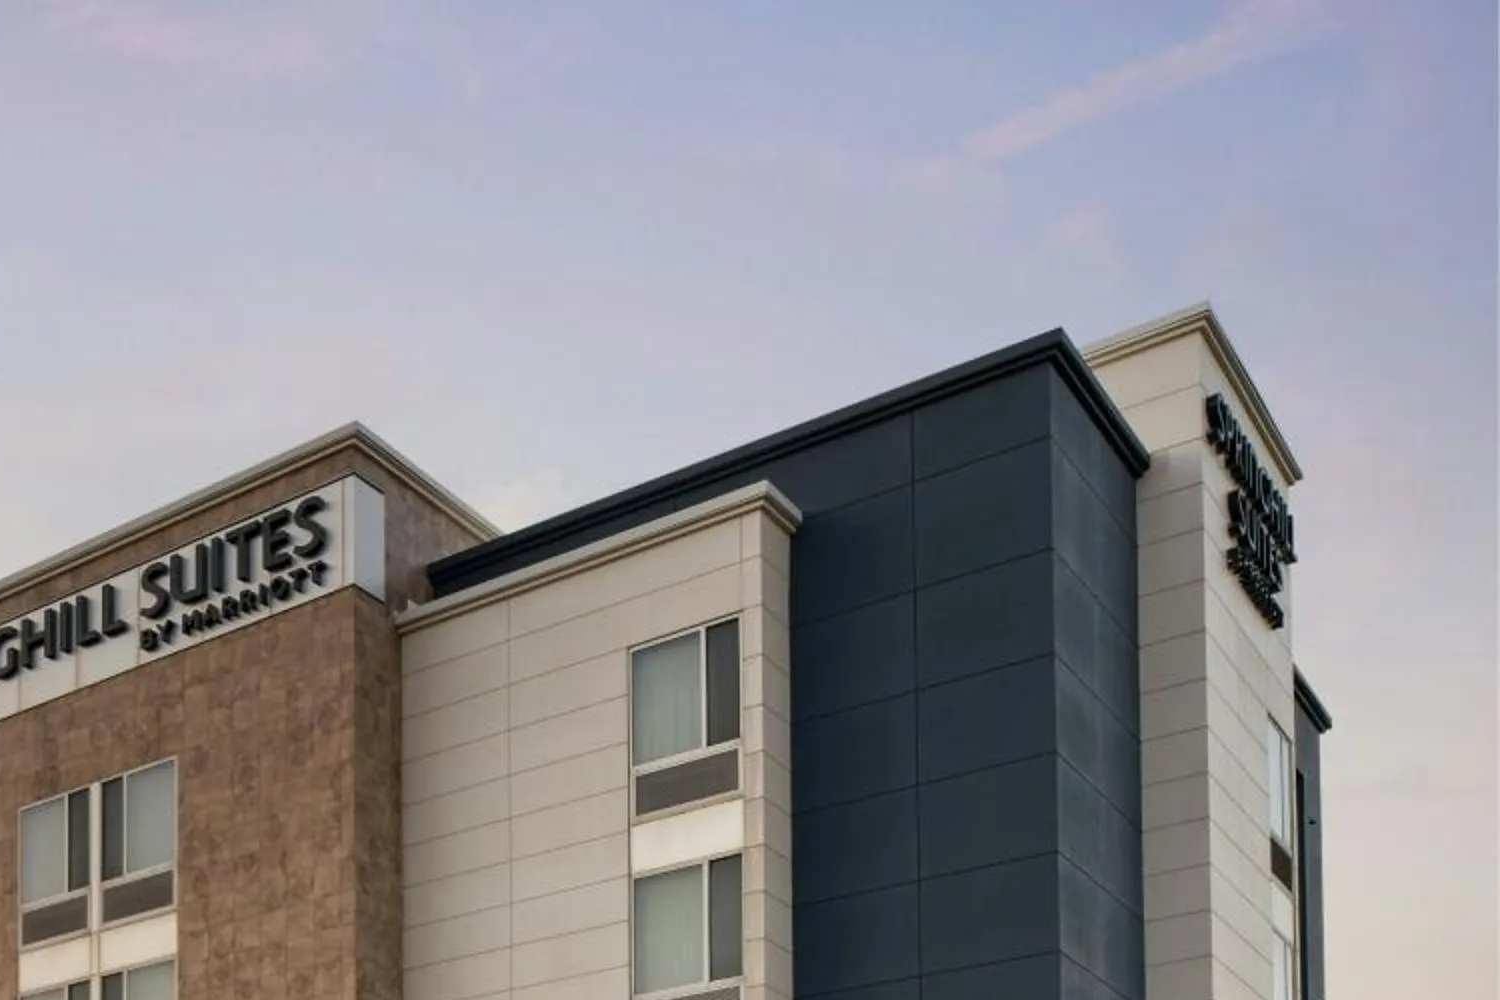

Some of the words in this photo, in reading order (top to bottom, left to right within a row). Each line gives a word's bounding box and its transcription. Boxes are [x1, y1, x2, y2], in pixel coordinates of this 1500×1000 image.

[140, 496, 327, 619] SUITES
[140, 619, 176, 652] BY
[182, 560, 328, 636] MARRIOTT
